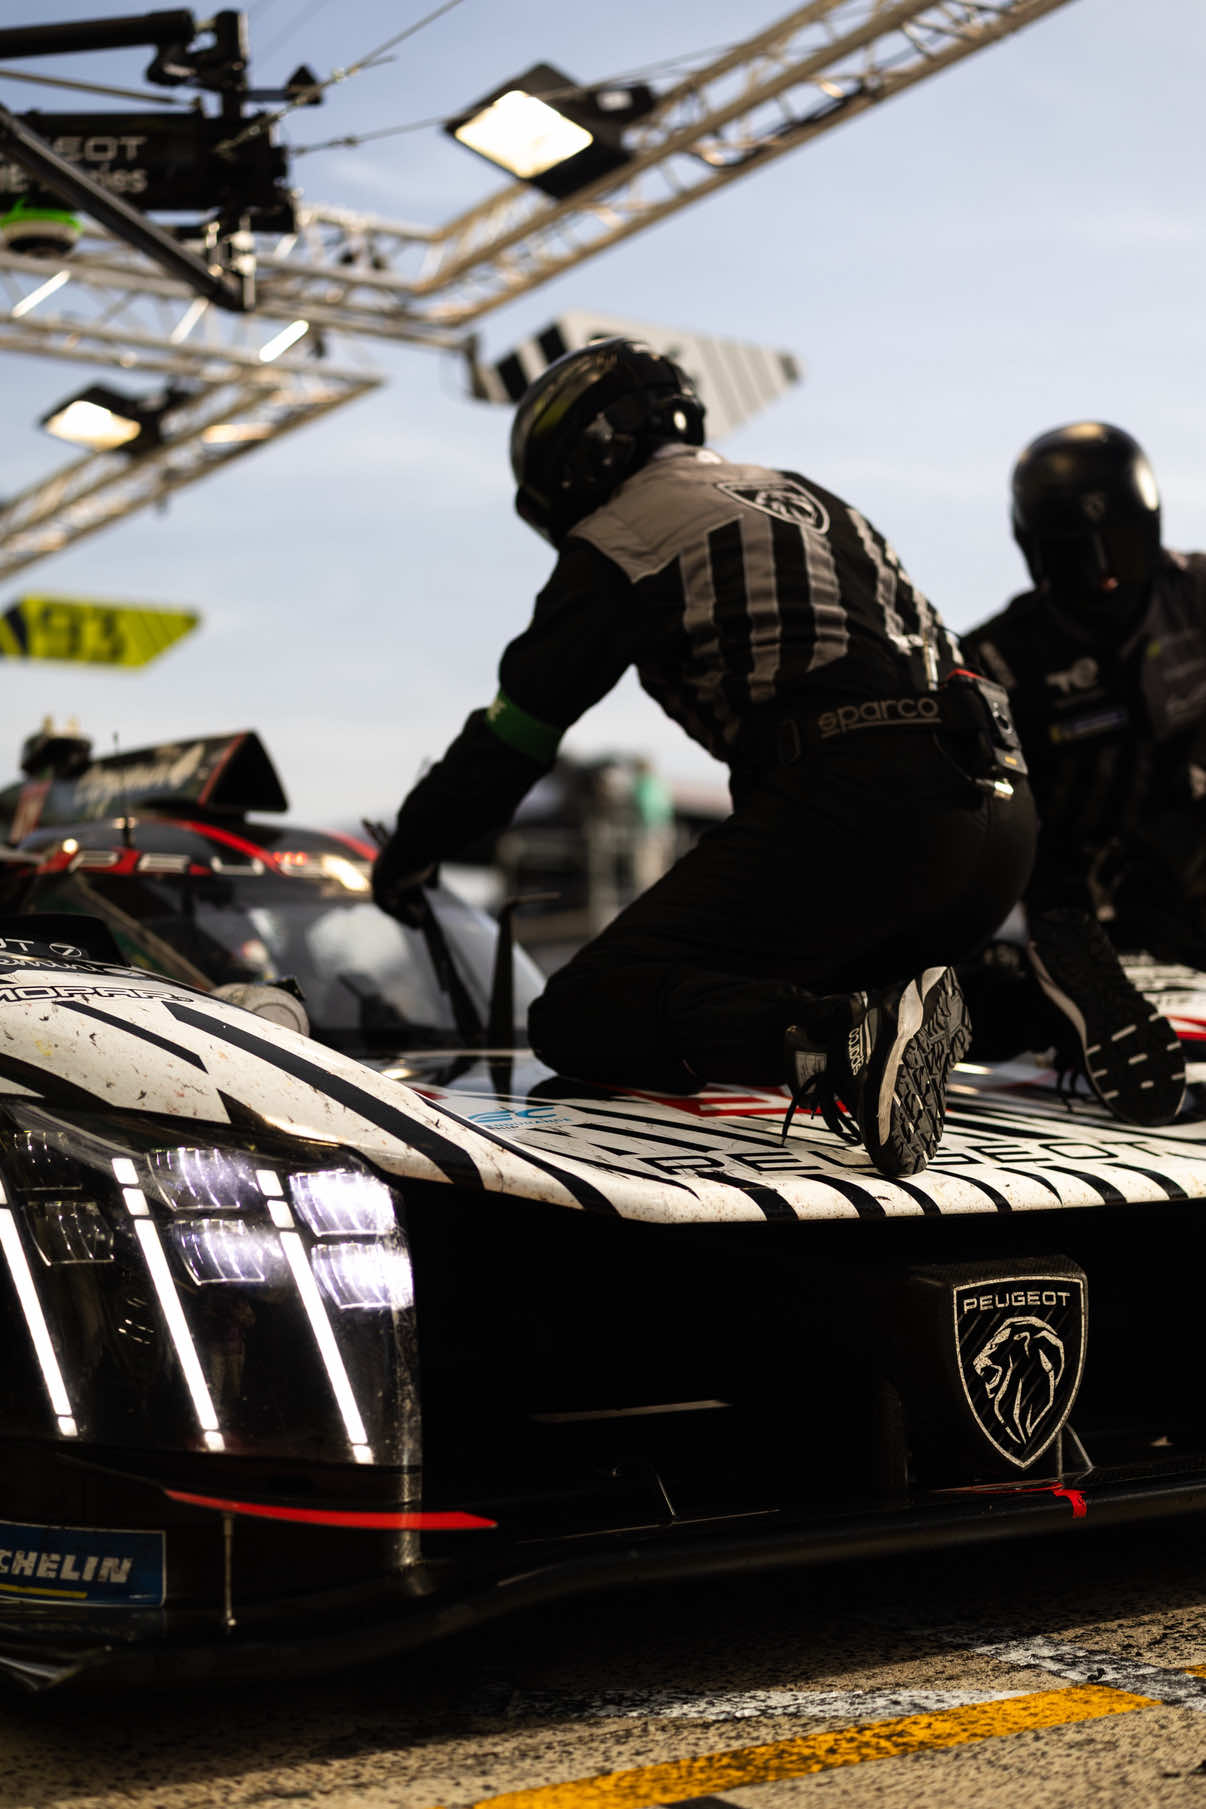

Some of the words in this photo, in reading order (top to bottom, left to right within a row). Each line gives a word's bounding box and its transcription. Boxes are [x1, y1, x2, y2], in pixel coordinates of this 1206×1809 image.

[52, 135, 148, 162] EOT
[818, 698, 938, 733] sparco
[963, 1290, 1071, 1314] PEUGEOT
